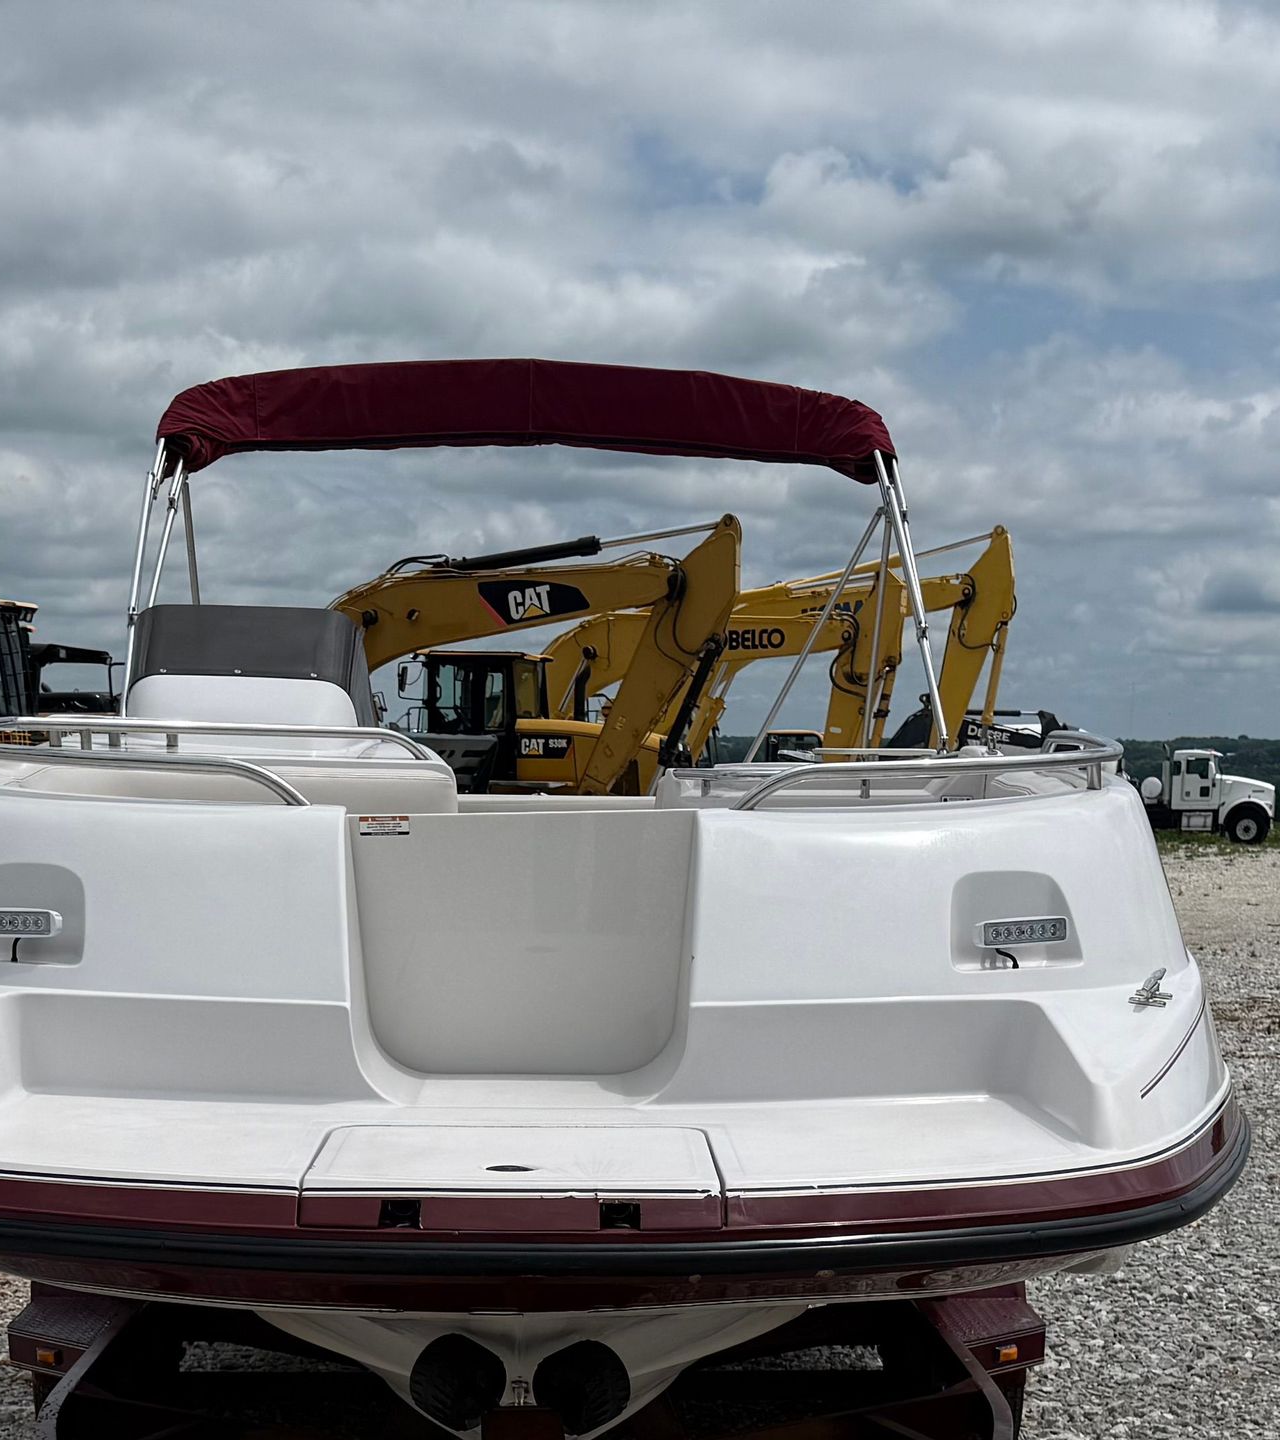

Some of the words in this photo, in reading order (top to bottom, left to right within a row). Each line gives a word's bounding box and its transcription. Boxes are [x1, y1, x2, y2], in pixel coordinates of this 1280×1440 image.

[507, 584, 551, 621] CAT
[722, 628, 785, 651] BELCO
[521, 738, 546, 755] CAT
